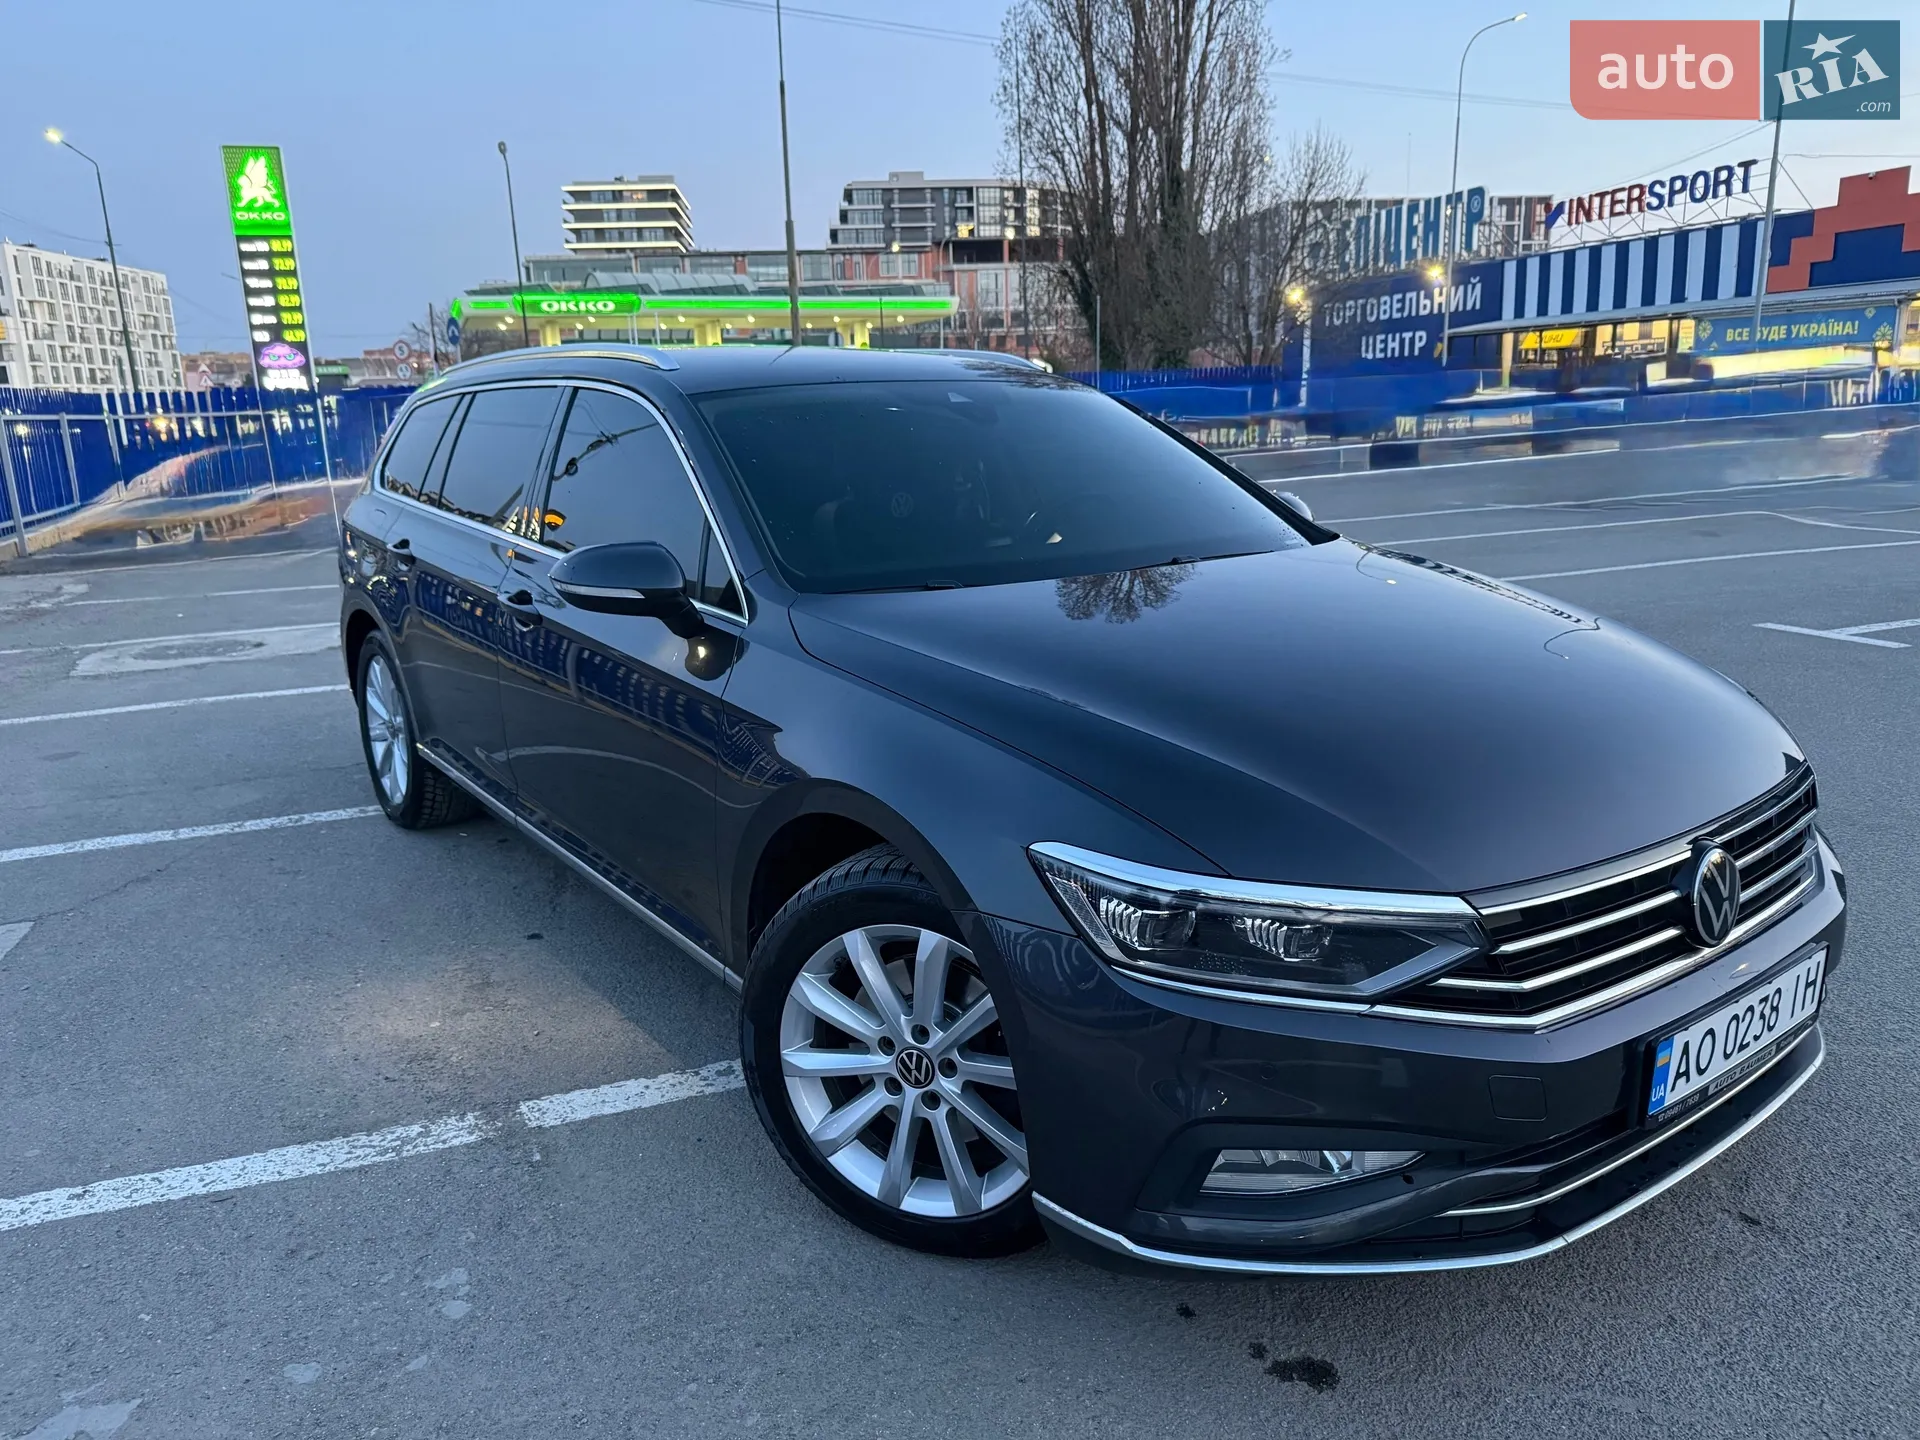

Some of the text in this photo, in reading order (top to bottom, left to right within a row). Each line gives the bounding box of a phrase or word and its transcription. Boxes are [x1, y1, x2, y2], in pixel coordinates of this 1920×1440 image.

[1567, 158, 1759, 227] INTERSPORT
[235, 211, 287, 221] OKKO
[541, 300, 616, 312] OKKO
[1323, 276, 1482, 327] ТОРГОВЕЛЬНИЙ
[1726, 327, 1749, 342] ВСЕ
[1791, 319, 1859, 339] УКРАЇНА!
[1361, 330, 1427, 360] ЦЕНТР
[1670, 960, 1821, 1092] AO 0238 IH
[1651, 1083, 1665, 1102] UA
[1713, 1071, 1737, 1091] AUTO
